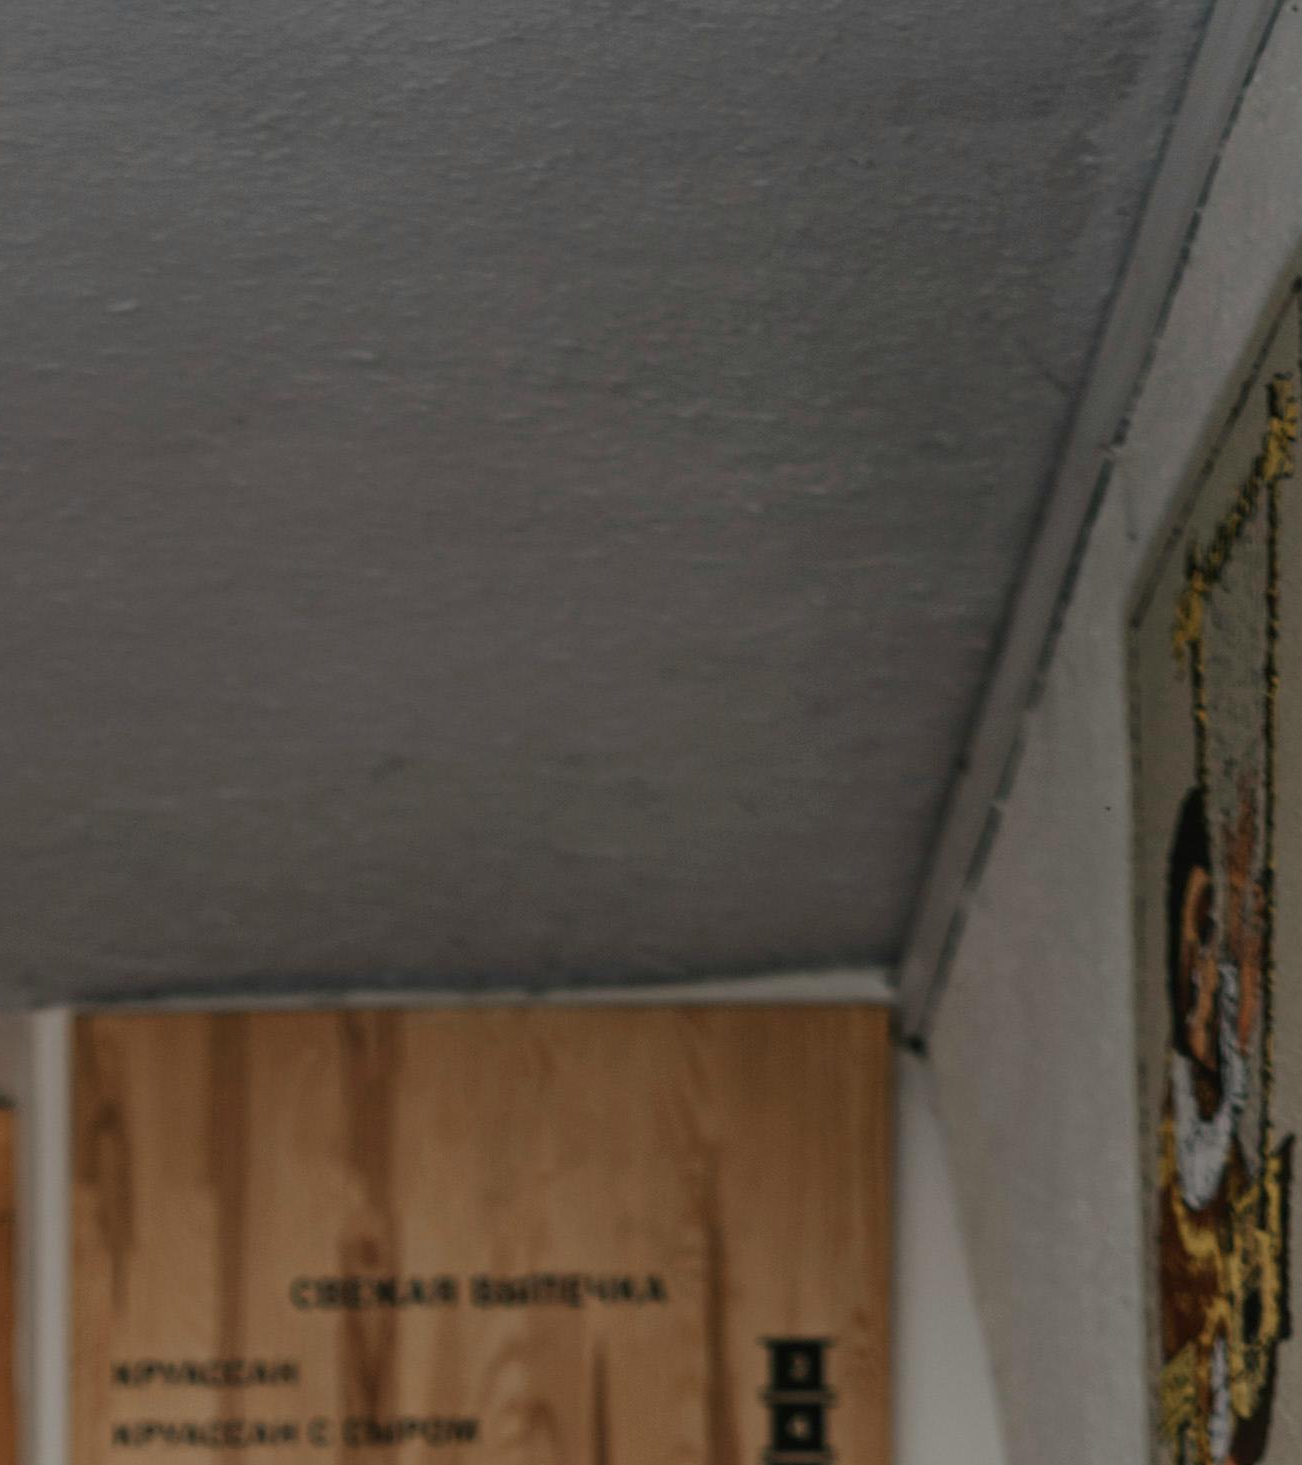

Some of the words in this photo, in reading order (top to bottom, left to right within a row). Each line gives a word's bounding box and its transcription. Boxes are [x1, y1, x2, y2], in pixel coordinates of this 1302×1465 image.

[291, 1275, 460, 1312] СВЕЖАЯ
[470, 1272, 668, 1310] ВЫПЕЧКА
[112, 1356, 300, 1390] КРУАССАН
[112, 1416, 300, 1451] КРУАССАН
[308, 1416, 335, 1449] С
[344, 1414, 483, 1449] СЫРОМ
